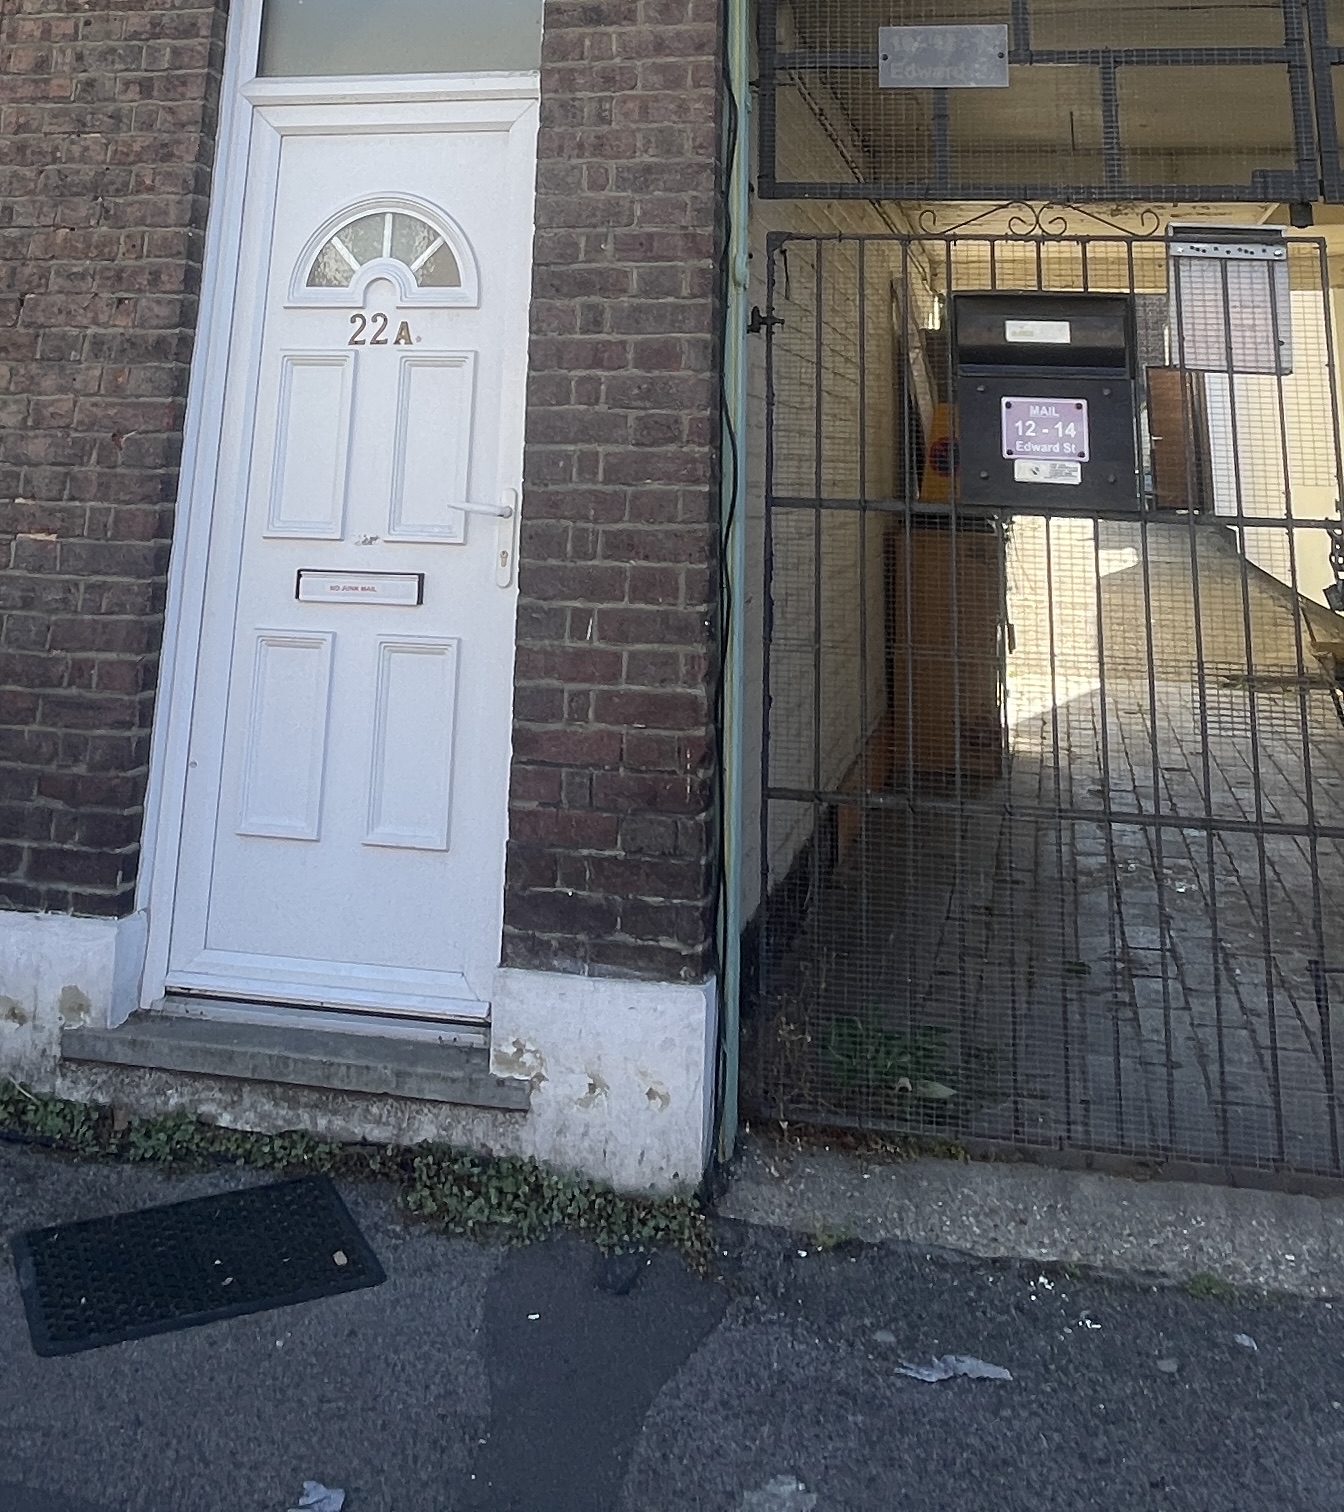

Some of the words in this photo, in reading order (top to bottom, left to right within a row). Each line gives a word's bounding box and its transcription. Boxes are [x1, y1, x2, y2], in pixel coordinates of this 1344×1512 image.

[348, 312, 413, 346] 22A
[1029, 405, 1060, 417] MAIL
[1014, 420, 1036, 437] 12
[1054, 421, 1077, 438] 14
[1015, 440, 1060, 454] Edward
[1063, 441, 1076, 454] St
